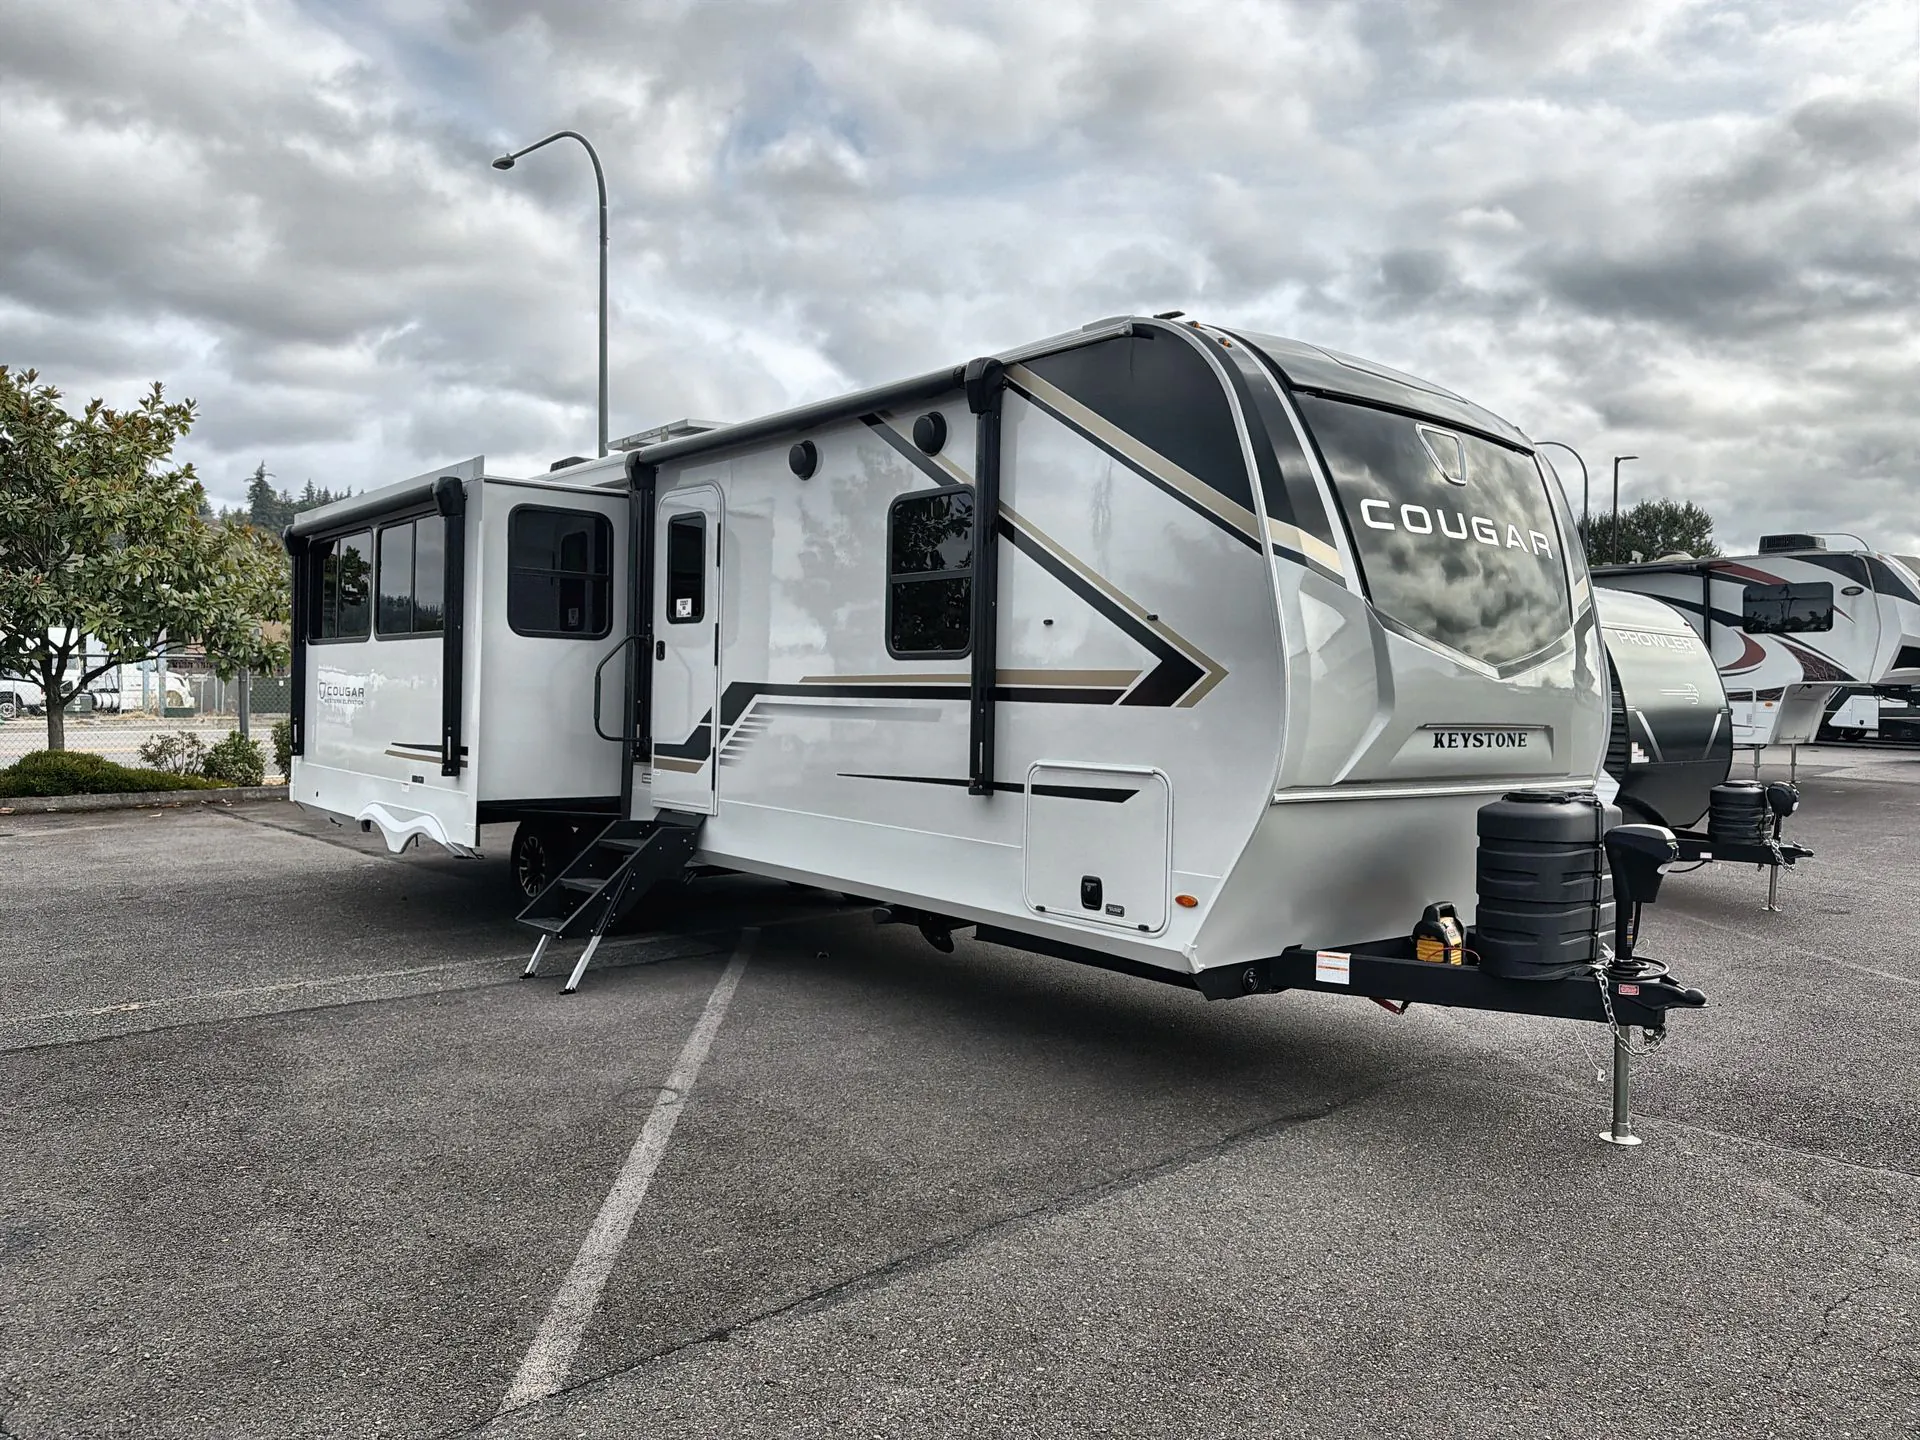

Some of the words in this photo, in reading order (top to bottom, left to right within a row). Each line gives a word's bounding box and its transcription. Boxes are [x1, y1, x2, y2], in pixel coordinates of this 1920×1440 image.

[1360, 498, 1553, 560] COUGAR
[1615, 630, 1693, 650] PROWLER
[327, 686, 365, 697] COUGAR
[1433, 732, 1528, 748] KEYSTONE
